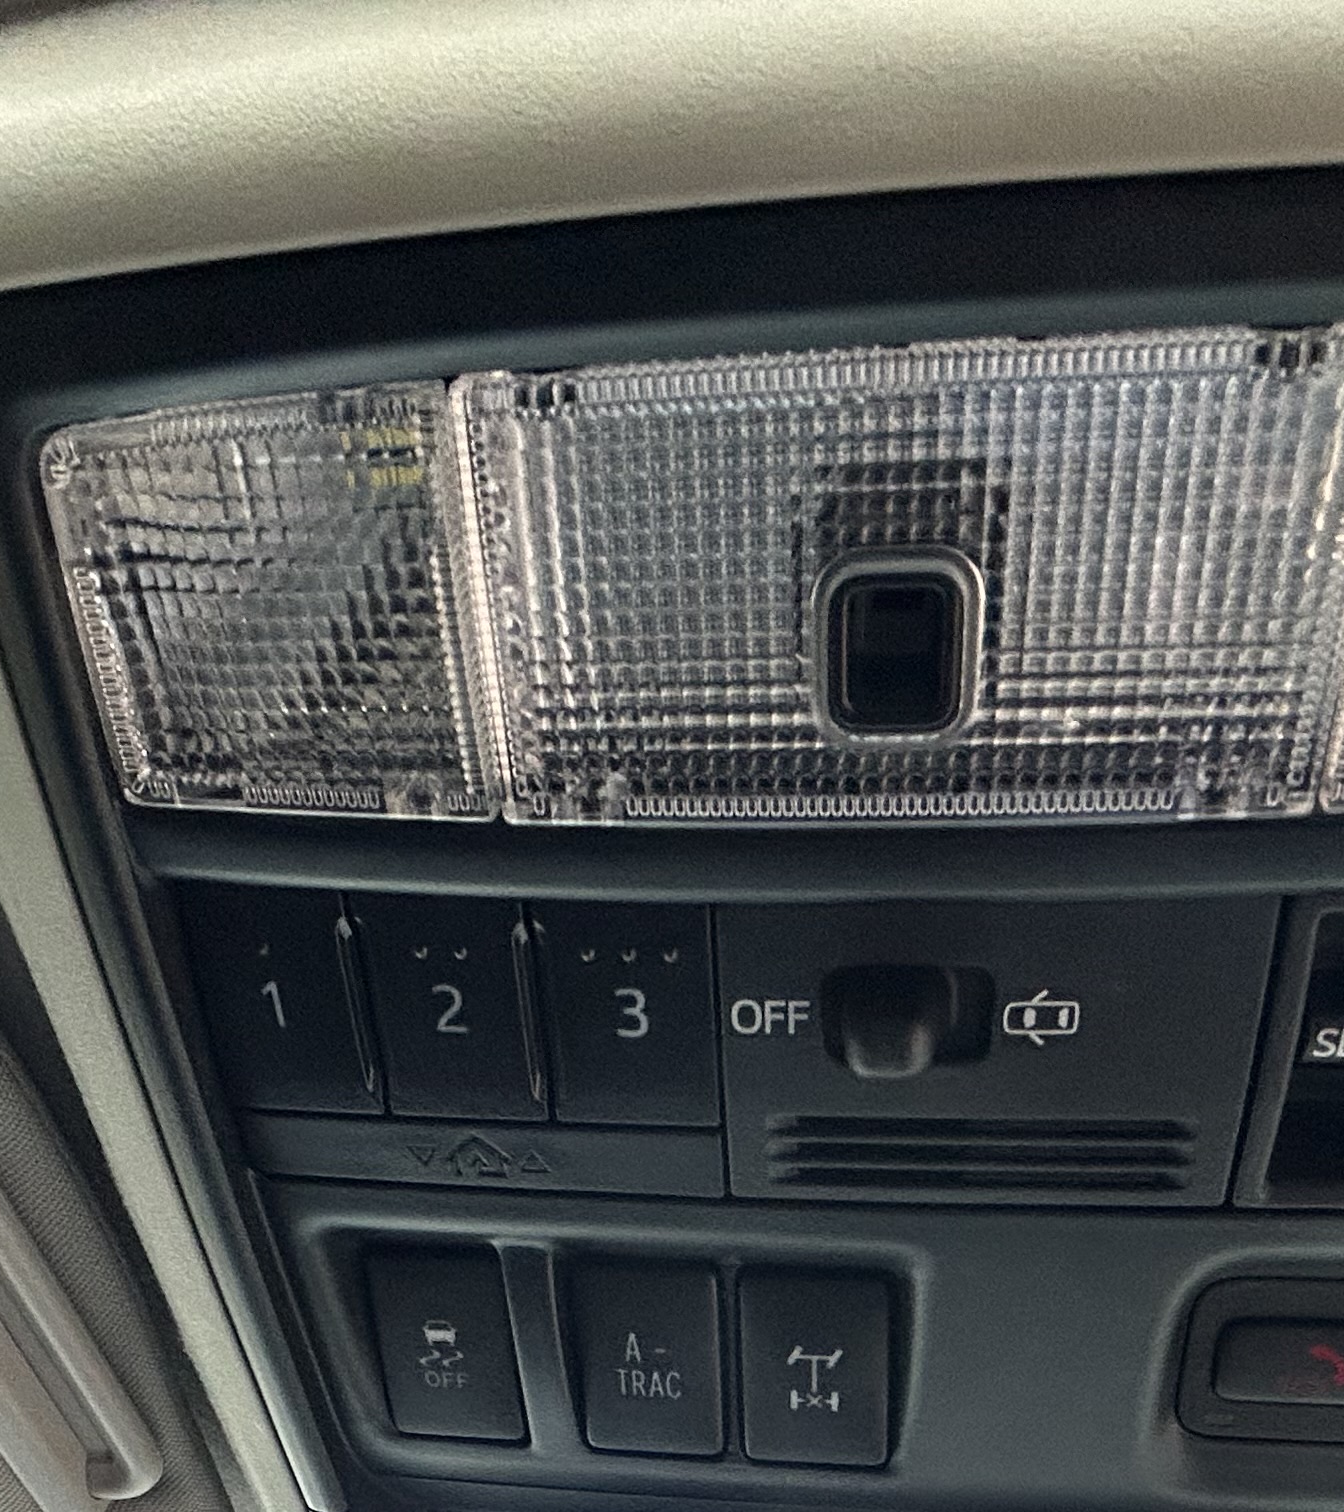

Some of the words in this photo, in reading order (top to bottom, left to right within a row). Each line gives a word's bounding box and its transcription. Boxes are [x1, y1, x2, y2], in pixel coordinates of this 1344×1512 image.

[261, 980, 286, 1028] 1
[432, 984, 469, 1034] 2
[614, 988, 650, 1038] 3
[730, 999, 811, 1035] OFF
[423, 1369, 468, 1389] OFF
[615, 1366, 682, 1400] TRAC
